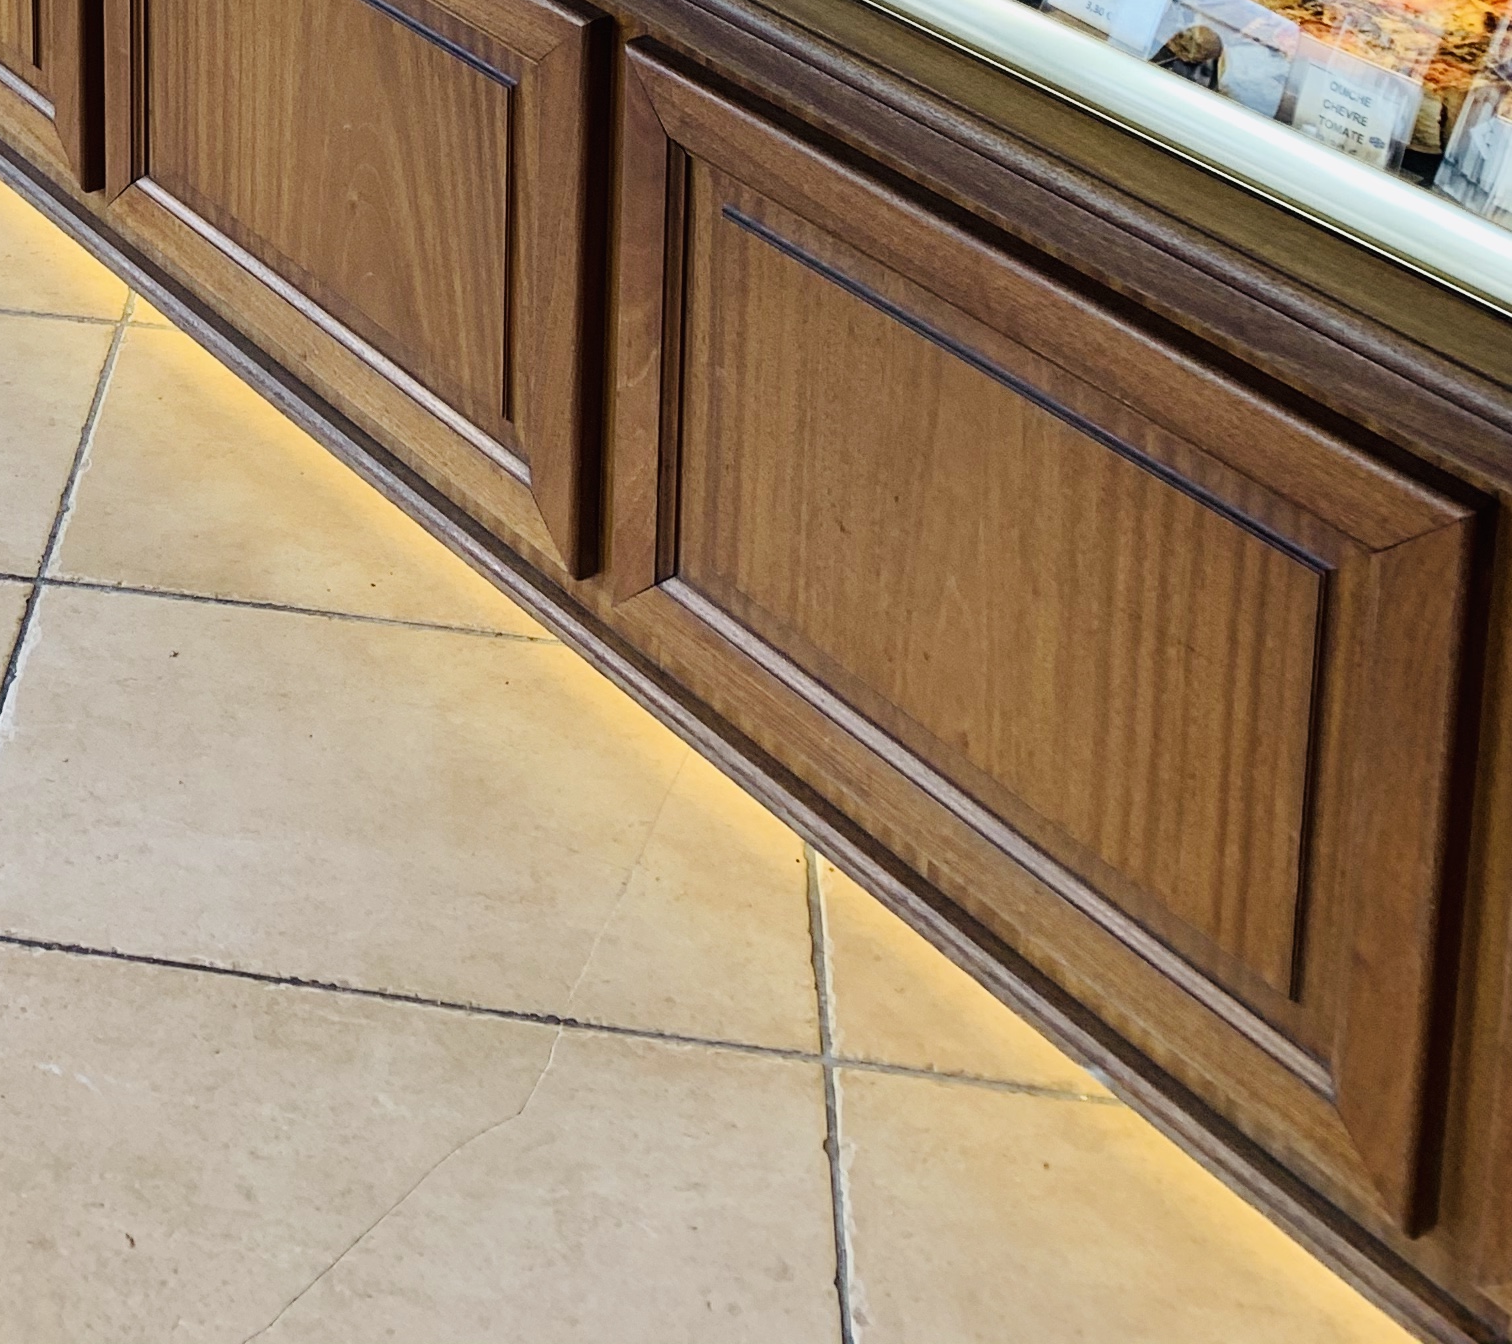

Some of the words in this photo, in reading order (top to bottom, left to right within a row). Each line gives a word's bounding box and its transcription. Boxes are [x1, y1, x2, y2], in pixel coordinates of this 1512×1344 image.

[1329, 80, 1373, 109] QUICHE
[1322, 98, 1369, 127] CHEVRE
[1318, 114, 1365, 145] TOMATE
